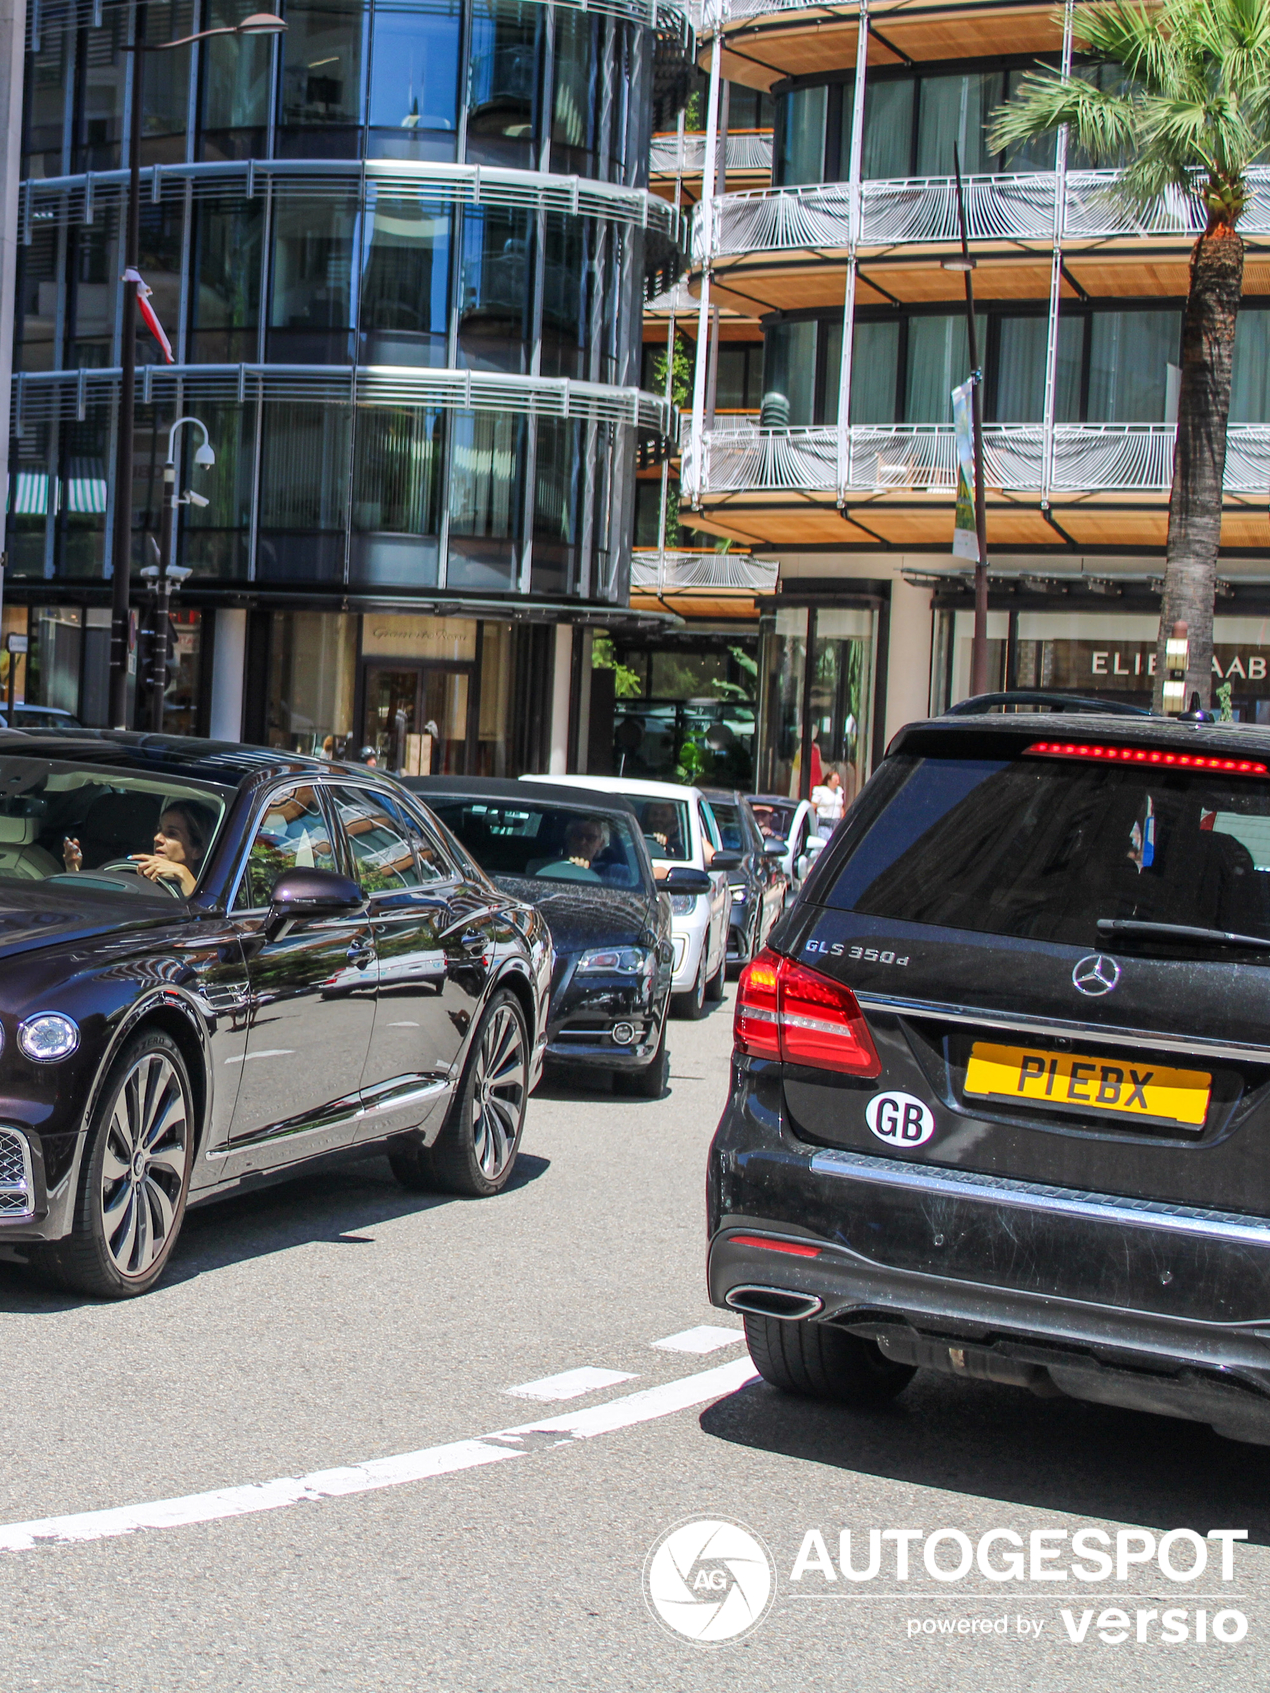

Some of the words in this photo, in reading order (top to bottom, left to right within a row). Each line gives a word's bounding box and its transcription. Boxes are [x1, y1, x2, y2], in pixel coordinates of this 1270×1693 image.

[1211, 655, 1268, 680] AAB
[804, 939, 845, 957] GLS
[875, 1097, 924, 1142] GB
